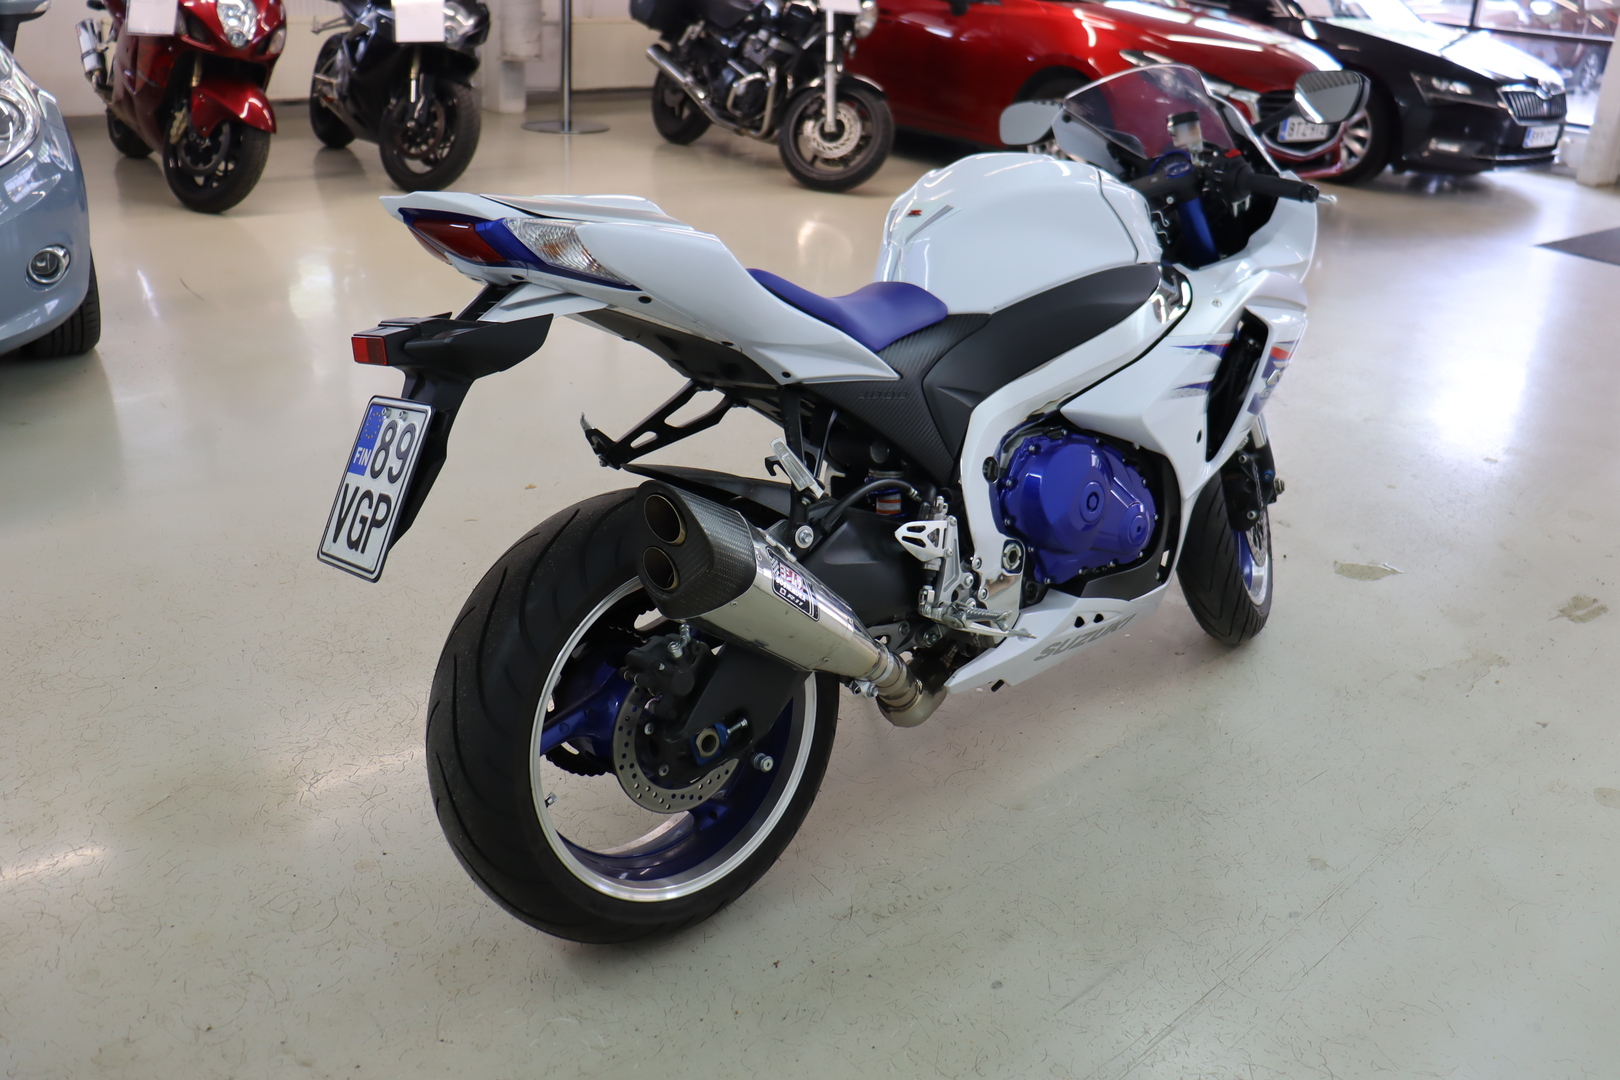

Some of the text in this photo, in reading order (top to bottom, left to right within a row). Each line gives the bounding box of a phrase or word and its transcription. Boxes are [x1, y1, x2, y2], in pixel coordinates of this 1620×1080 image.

[353, 446, 372, 467] FIN
[370, 419, 418, 485] 89
[332, 483, 393, 554] VGP
[1033, 612, 1138, 662] SUZUKI
